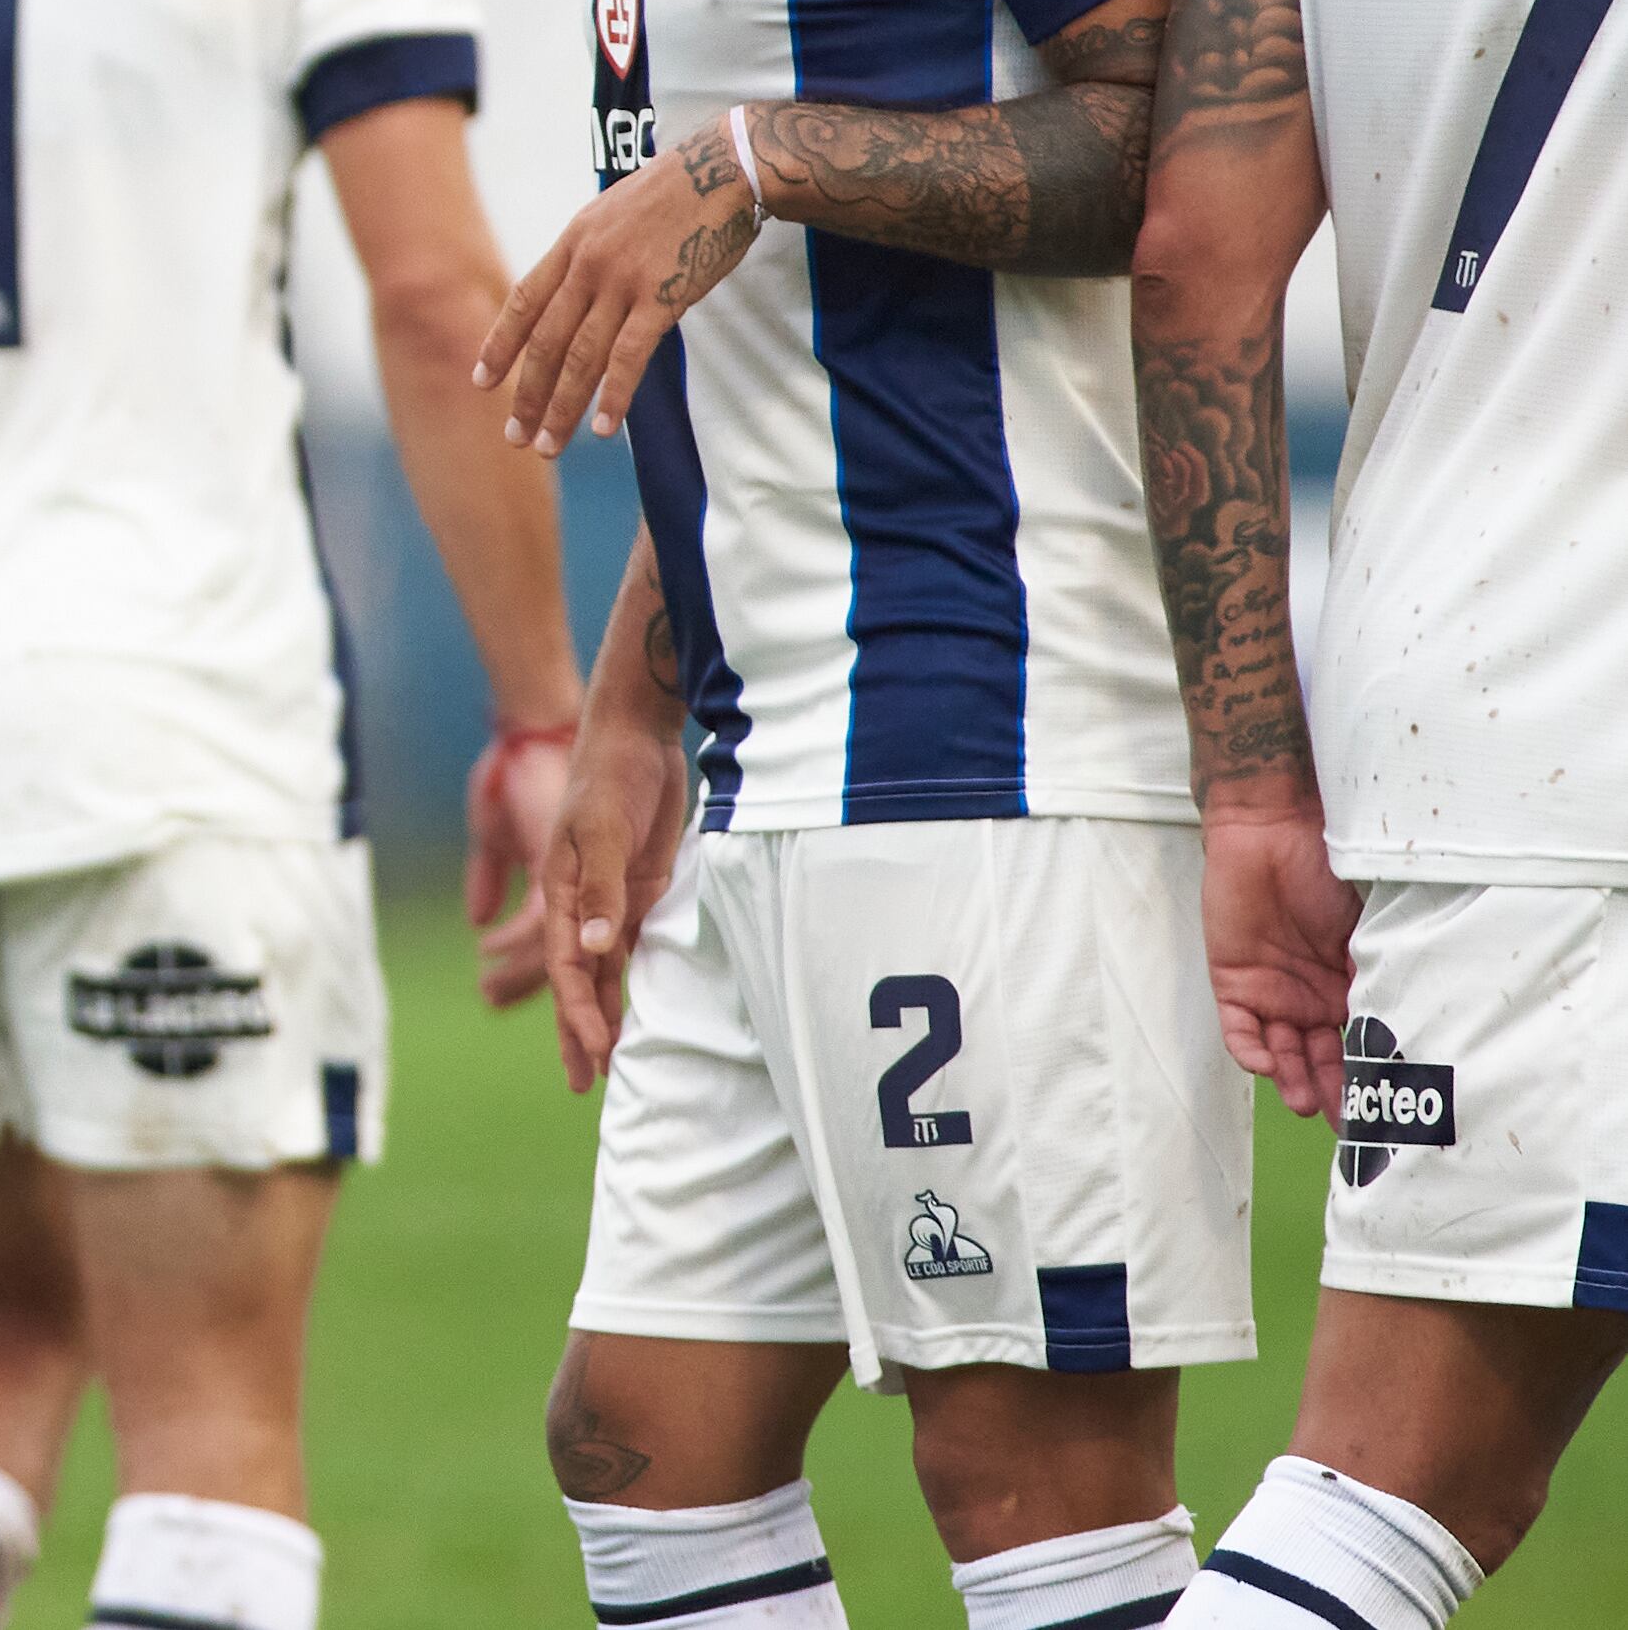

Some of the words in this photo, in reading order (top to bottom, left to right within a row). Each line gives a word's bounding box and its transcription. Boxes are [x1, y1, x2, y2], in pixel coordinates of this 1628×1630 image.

[870, 974, 973, 1149] 2
[1342, 1076, 1444, 1126] ácteo
[907, 1263, 922, 1277] LE
[946, 1257, 991, 1274] SPORTIF
